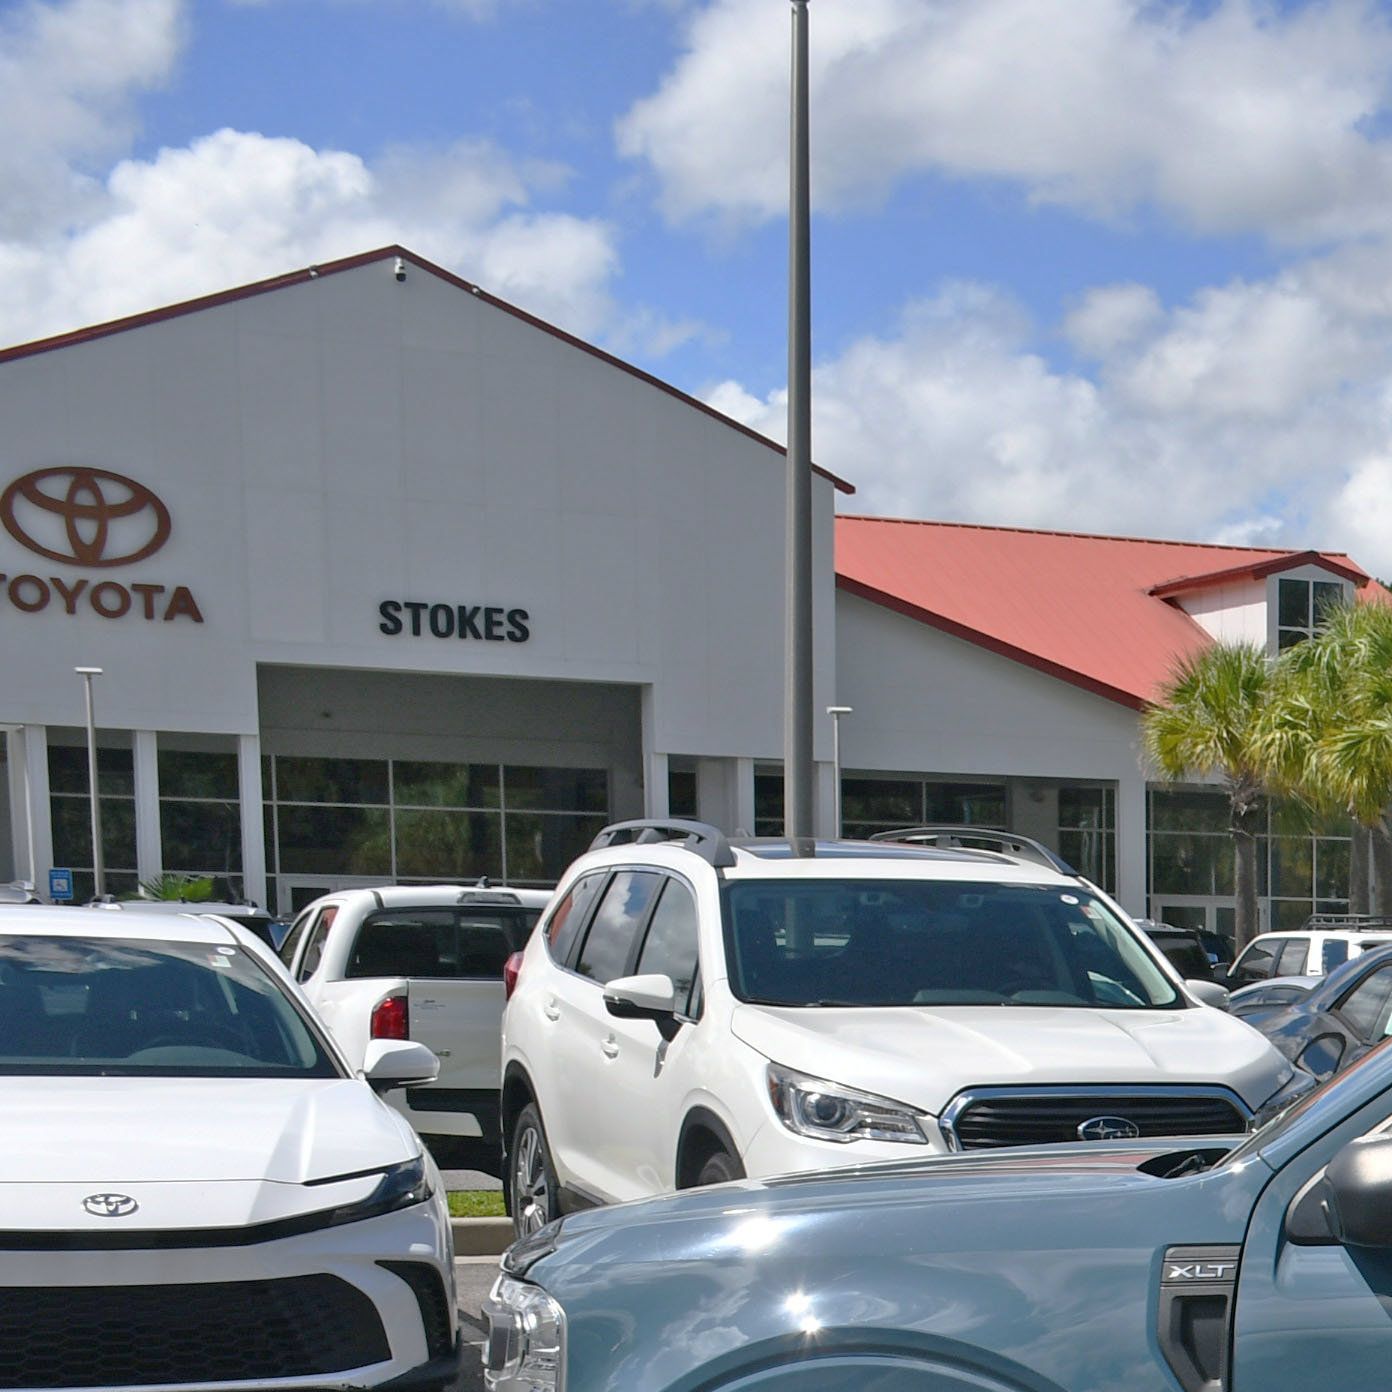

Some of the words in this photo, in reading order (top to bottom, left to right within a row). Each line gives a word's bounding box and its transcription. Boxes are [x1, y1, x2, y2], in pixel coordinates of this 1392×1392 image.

[0, 573, 204, 623] OYOTA
[379, 600, 530, 642] STOKES
[1168, 1264, 1235, 1279] XLT
